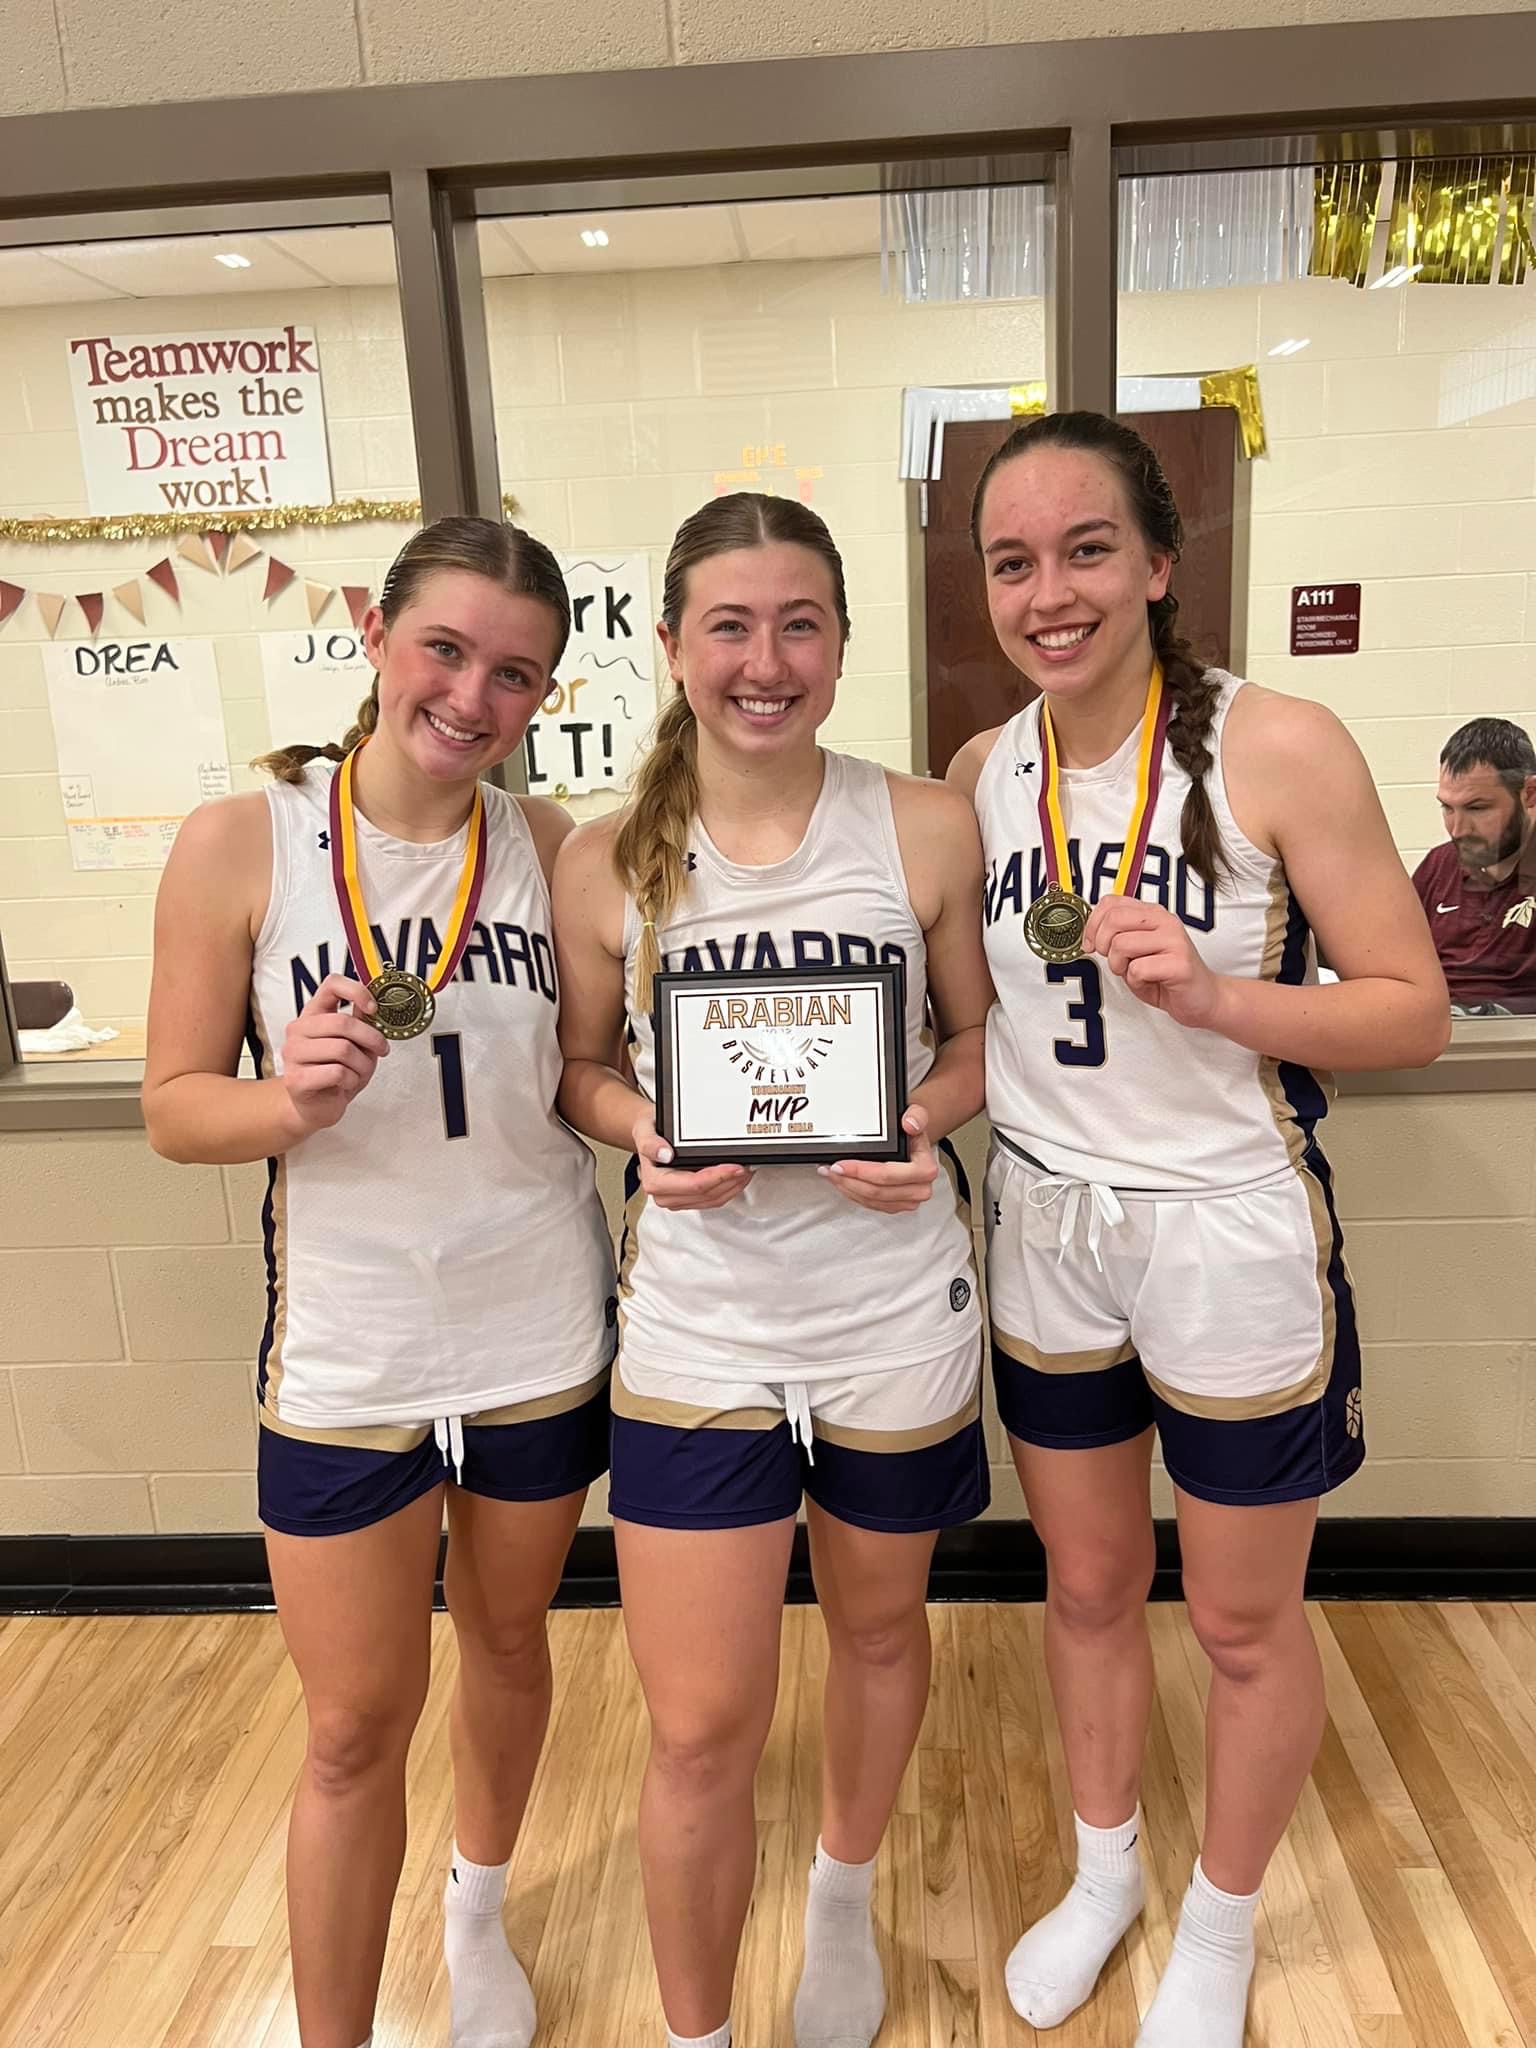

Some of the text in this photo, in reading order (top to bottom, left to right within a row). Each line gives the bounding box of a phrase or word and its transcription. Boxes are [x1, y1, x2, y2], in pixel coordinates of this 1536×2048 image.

[70, 325, 319, 386] Teamwork
[93, 377, 304, 424] makes the
[121, 425, 286, 471] Dream
[159, 466, 273, 509] work!
[1297, 590, 1334, 606] A111
[75, 643, 179, 676] DREA
[526, 723, 613, 782] IT!
[662, 930, 906, 973] VARR
[703, 994, 852, 1030] ARABIAN
[1045, 957, 1108, 1069] 3
[722, 1037, 833, 1083] BASKETBALL
[431, 1032, 470, 1141] 1
[749, 1096, 809, 1122] MVP
